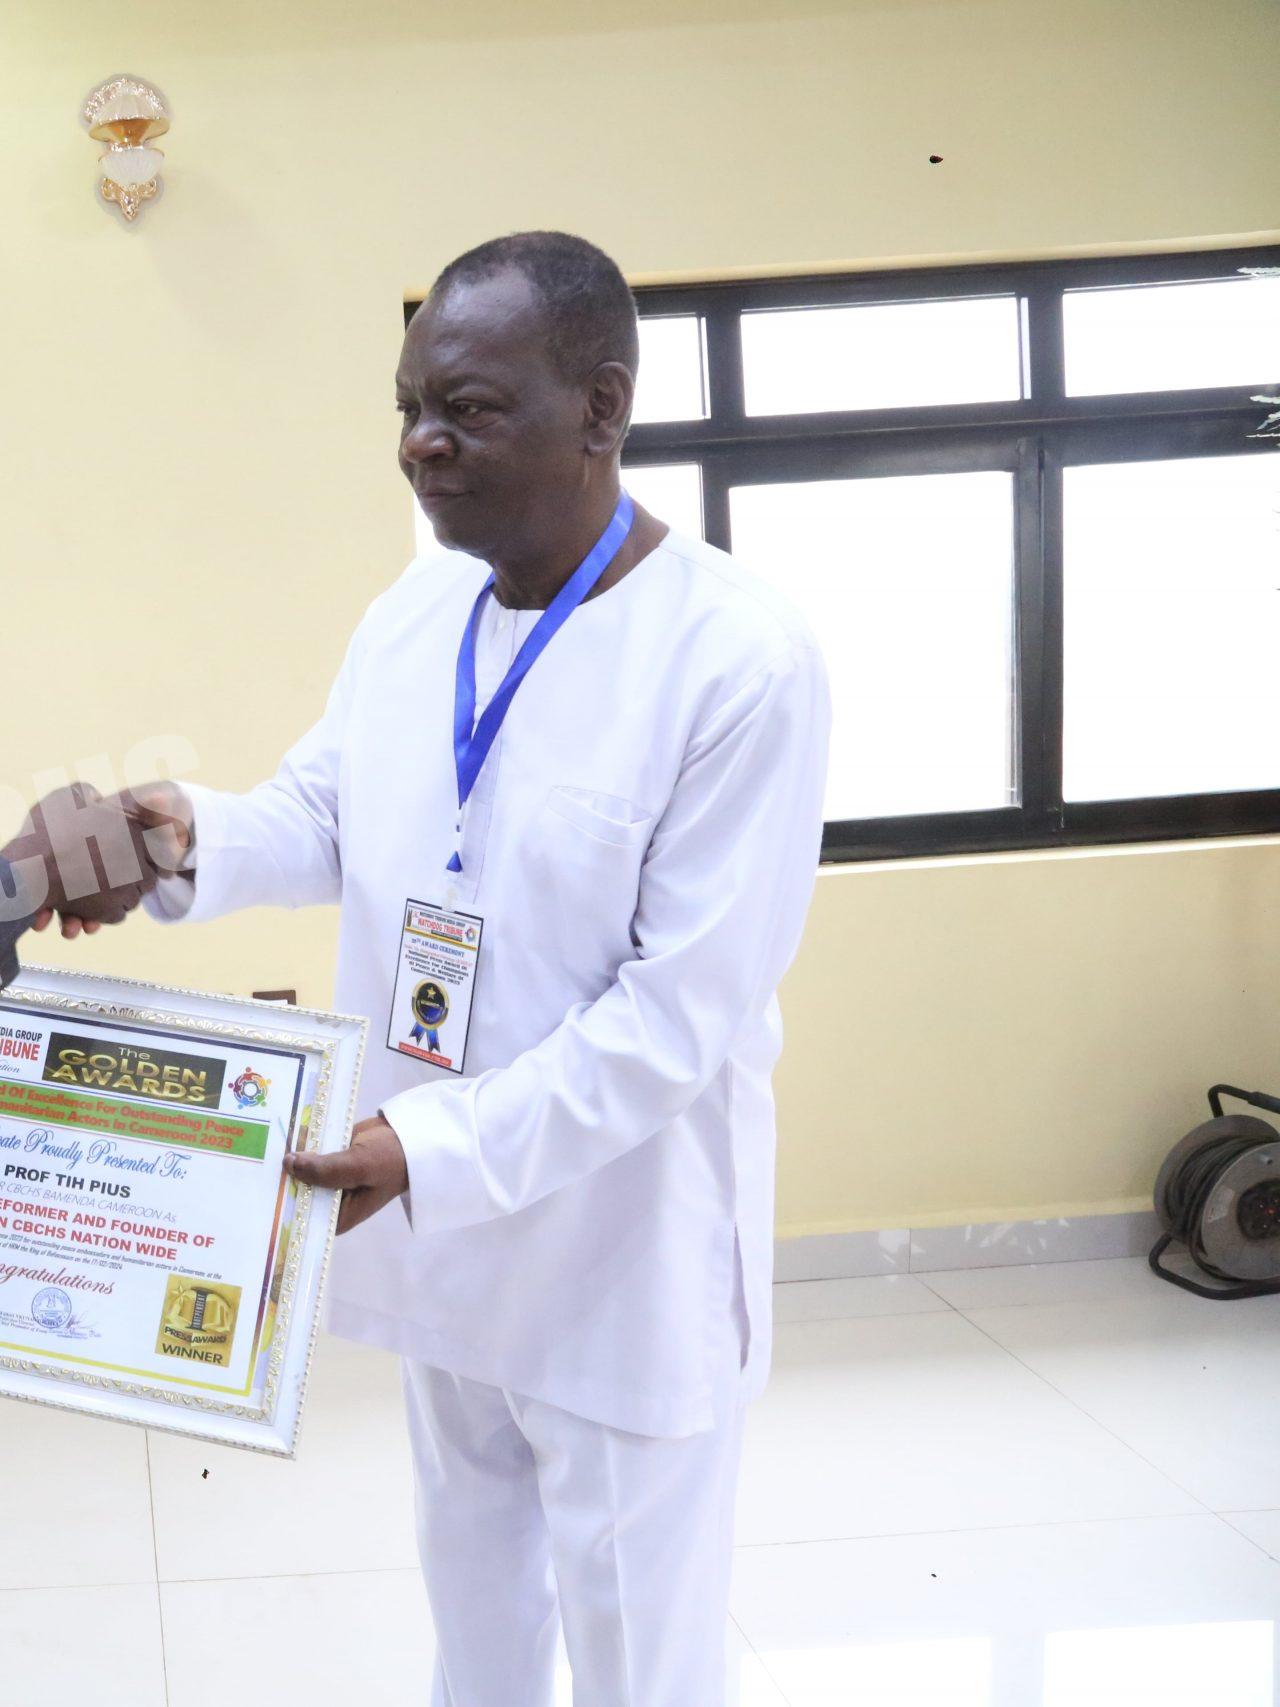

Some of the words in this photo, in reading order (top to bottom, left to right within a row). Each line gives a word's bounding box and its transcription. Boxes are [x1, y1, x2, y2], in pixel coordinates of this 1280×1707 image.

[15, 1030, 42, 1042] GROUP
[119, 1047, 150, 1060] The
[51, 1064, 207, 1102] AWARDS
[59, 1049, 207, 1087] GOLDEN
[9, 1086, 25, 1099] Of
[28, 1090, 93, 1110] Excellence
[96, 1099, 116, 1115] For
[121, 1106, 202, 1132] Outstanding
[205, 1119, 244, 1137] Peace
[68, 1111, 110, 1128] Actors
[129, 1118, 196, 1143] Cameroon
[201, 1133, 233, 1149] 2023
[23, 1128, 83, 1169] Proudly
[86, 1139, 161, 1175] Presented
[159, 1150, 192, 1180] To:
[4, 1164, 50, 1183] PROF
[56, 1173, 85, 1190] TIH
[89, 1180, 131, 1199] PIUS
[6, 1183, 41, 1197] CBCHS
[43, 1187, 96, 1208] BAMENDA
[97, 1200, 162, 1220] CAMEROON
[12, 1219, 66, 1239] CBCHS
[70, 1230, 132, 1252] NATION
[136, 1242, 178, 1261] WIDE
[72, 1213, 107, 1229] AND
[111, 1219, 189, 1244] FOUNDER
[193, 1234, 216, 1249] OF
[161, 1343, 223, 1364] WINNER
